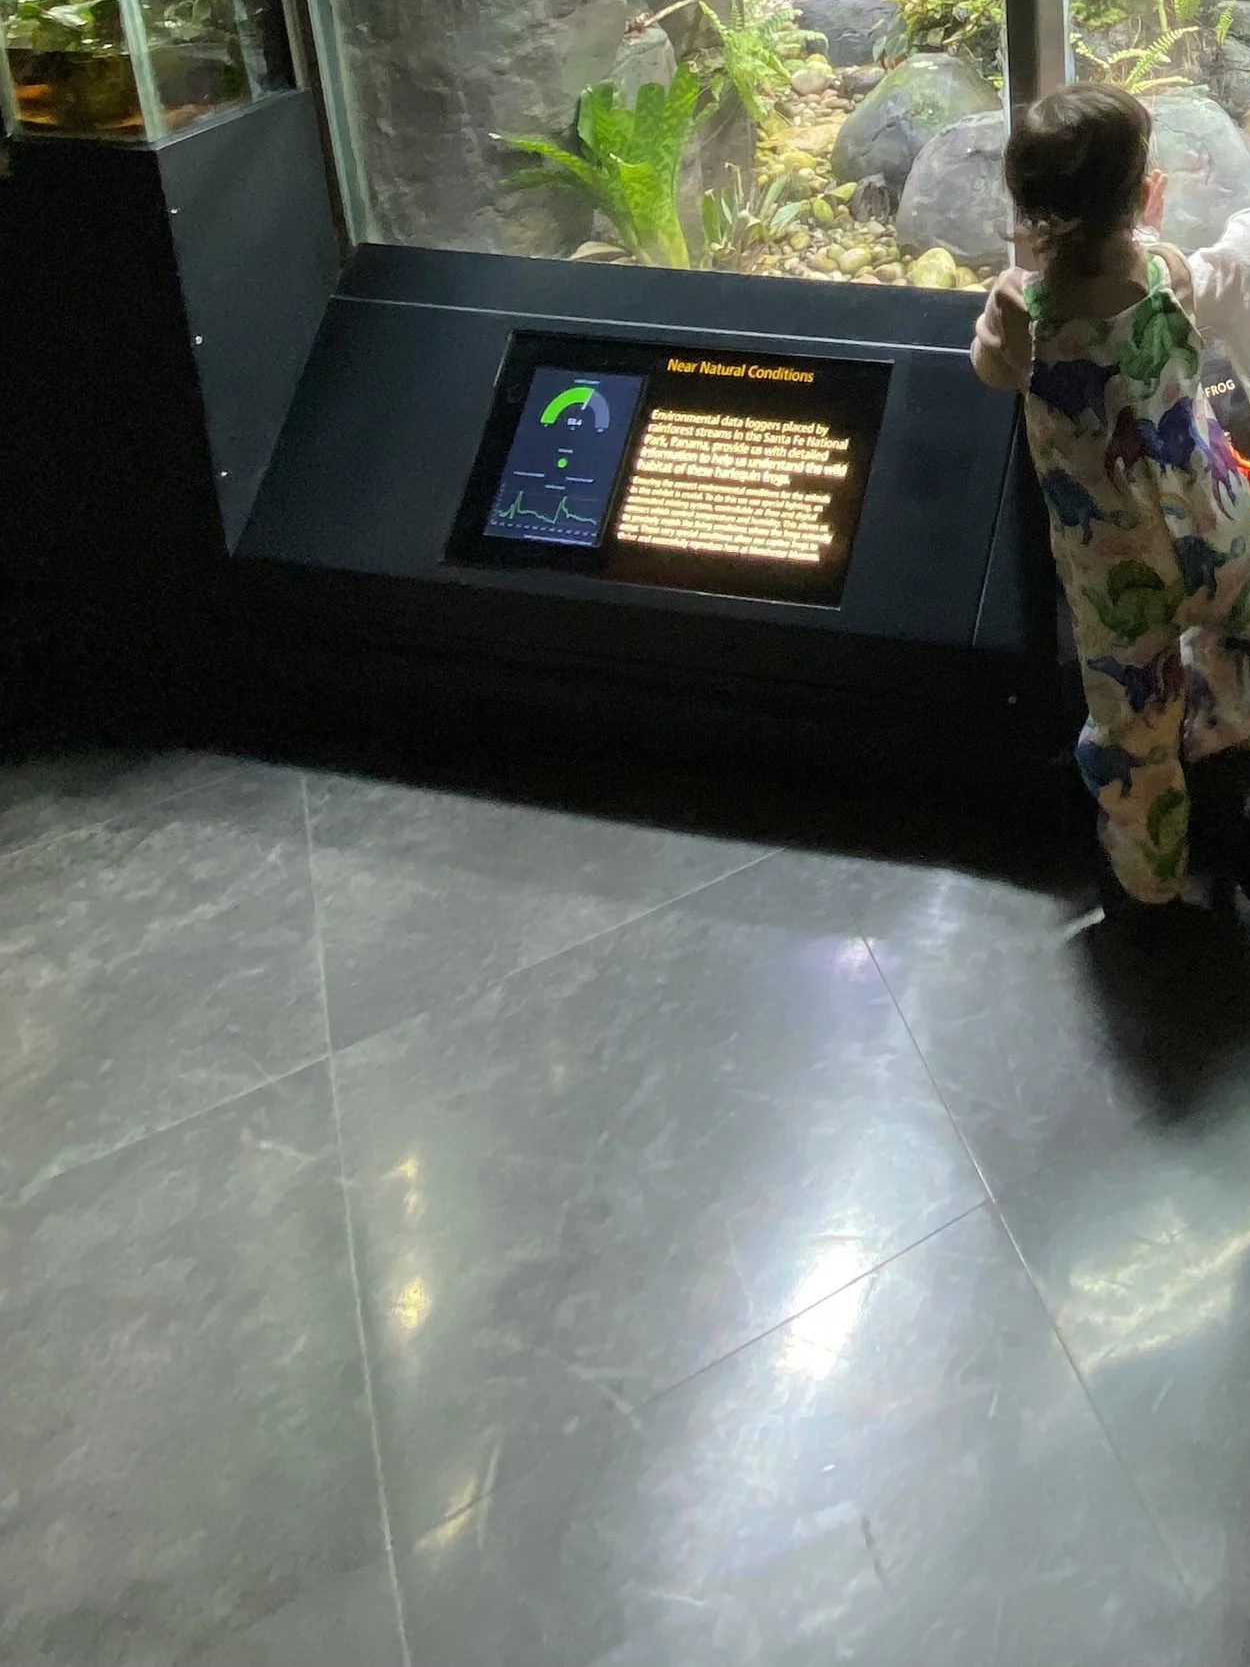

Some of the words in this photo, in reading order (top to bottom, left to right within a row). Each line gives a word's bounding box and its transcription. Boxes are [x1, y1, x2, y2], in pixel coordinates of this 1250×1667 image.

[667, 358, 698, 373] Near
[700, 360, 746, 377] Natural
[748, 364, 815, 383] Conditions
[1204, 379, 1236, 398] FROG
[651, 409, 720, 425] Environmental
[721, 415, 743, 427] data
[745, 417, 781, 432] loggers
[782, 421, 815, 434] placed
[816, 423, 830, 437] by
[763, 432, 791, 445] Santa
[792, 435, 805, 446] Fe
